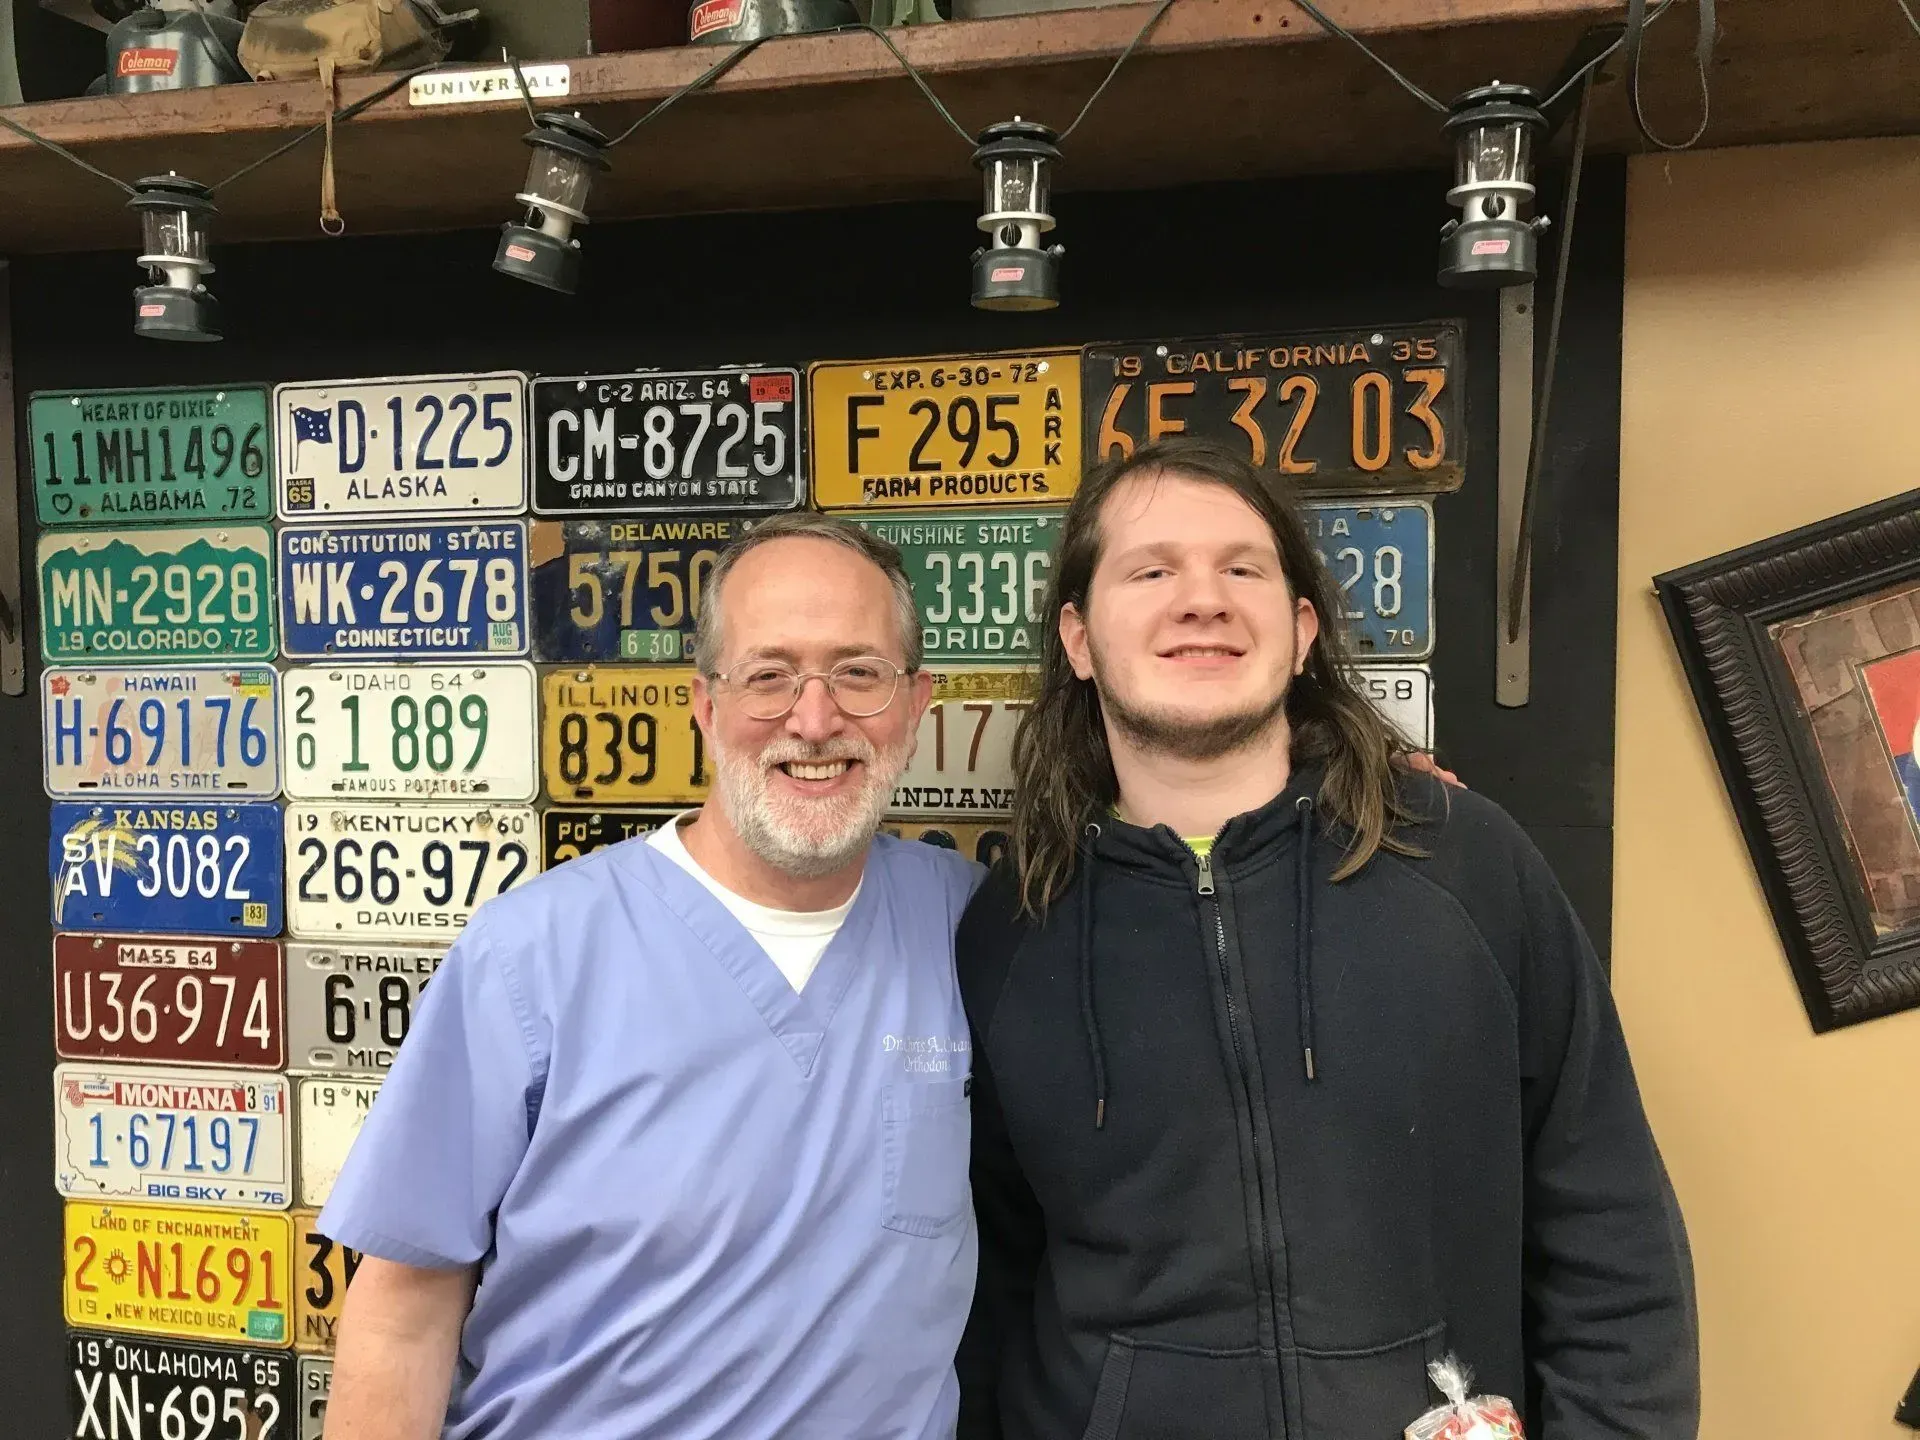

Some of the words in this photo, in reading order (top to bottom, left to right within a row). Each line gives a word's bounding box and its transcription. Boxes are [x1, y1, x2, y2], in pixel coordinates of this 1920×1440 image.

[695, 6, 730, 33] Coleman
[120, 50, 172, 73] Coleman
[1113, 357, 1142, 377] 19
[1165, 344, 1371, 374] CALIFORNIA
[1392, 340, 1437, 360] 35
[874, 369, 924, 390] EXP.
[1009, 363, 1039, 383] 72
[598, 382, 633, 403] C-2
[701, 379, 730, 400] 64
[82, 400, 139, 421] HEART
[144, 400, 163, 419] OF
[169, 399, 215, 418] DIXIE
[1227, 375, 1318, 474] 32
[1353, 367, 1445, 471] 03
[848, 395, 885, 474] F
[908, 394, 1020, 473] 295
[1044, 387, 1061, 466] ARK
[548, 401, 786, 482] CM-8725
[44, 422, 263, 485] 11MH1496
[288, 486, 313, 503] 65
[346, 475, 448, 501] ALASKA
[570, 484, 627, 499] GRAND
[632, 482, 701, 497] CANYON
[707, 480, 760, 496] STATE
[862, 477, 921, 498] FARM
[930, 473, 1049, 496] PRODUCTS
[101, 489, 207, 513] ALABAMA
[288, 533, 431, 555] CONSTITUTION
[447, 530, 516, 551] STATE
[610, 523, 731, 541] DELAWARE
[876, 525, 965, 545] SUNSHINE
[978, 525, 1033, 544] STATE
[1336, 545, 1403, 618] 28
[58, 631, 85, 651] 19
[92, 628, 221, 651] COLORADO
[230, 628, 258, 648] 72
[335, 627, 472, 648] CONNECTICUT
[492, 624, 513, 636] AUG
[493, 637, 513, 645] 1980
[922, 627, 1031, 649] ORIDA
[1386, 629, 1415, 645] 70
[123, 676, 197, 691] HAWAII
[346, 673, 411, 691] IDAHO
[430, 672, 463, 691] 64
[1369, 679, 1413, 700] 58
[559, 685, 691, 708] ILLINOIS
[341, 694, 369, 772] 1
[390, 694, 488, 773] 889
[559, 712, 659, 786] 839
[101, 772, 160, 788] ALOHA
[170, 772, 221, 789] STATE
[341, 778, 397, 793] FAMOUS
[404, 778, 477, 793] POTATOES
[113, 809, 218, 831] KANSAS
[297, 814, 318, 831] 19
[343, 814, 473, 833] KENTUCKY
[497, 815, 524, 835] 60
[136, 834, 251, 900] 3082
[249, 905, 262, 919] 83
[356, 911, 468, 927] DAVIESS
[120, 948, 177, 965] MASS
[188, 950, 214, 966] 64
[347, 1049, 398, 1068] MIC
[121, 1083, 238, 1110] MONTANA
[246, 1085, 256, 1109] 3
[263, 1095, 276, 1111] 91
[313, 1087, 335, 1106] 19
[147, 1184, 180, 1198] BIG
[185, 1186, 228, 1200] SKY
[91, 1216, 127, 1231] LAND
[133, 1218, 150, 1233] OF
[157, 1220, 260, 1241] ENCHANTMENT
[73, 1235, 99, 1293] 2
[137, 1240, 282, 1309] N1691
[78, 1298, 98, 1315] 19
[114, 1303, 144, 1319] NEW
[149, 1304, 202, 1321] MEXICO
[207, 1312, 237, 1329] USA
[306, 1314, 337, 1337] NY
[77, 1340, 100, 1367] 19
[115, 1345, 239, 1382] OKLAHOMA
[254, 1360, 281, 1387] 65
